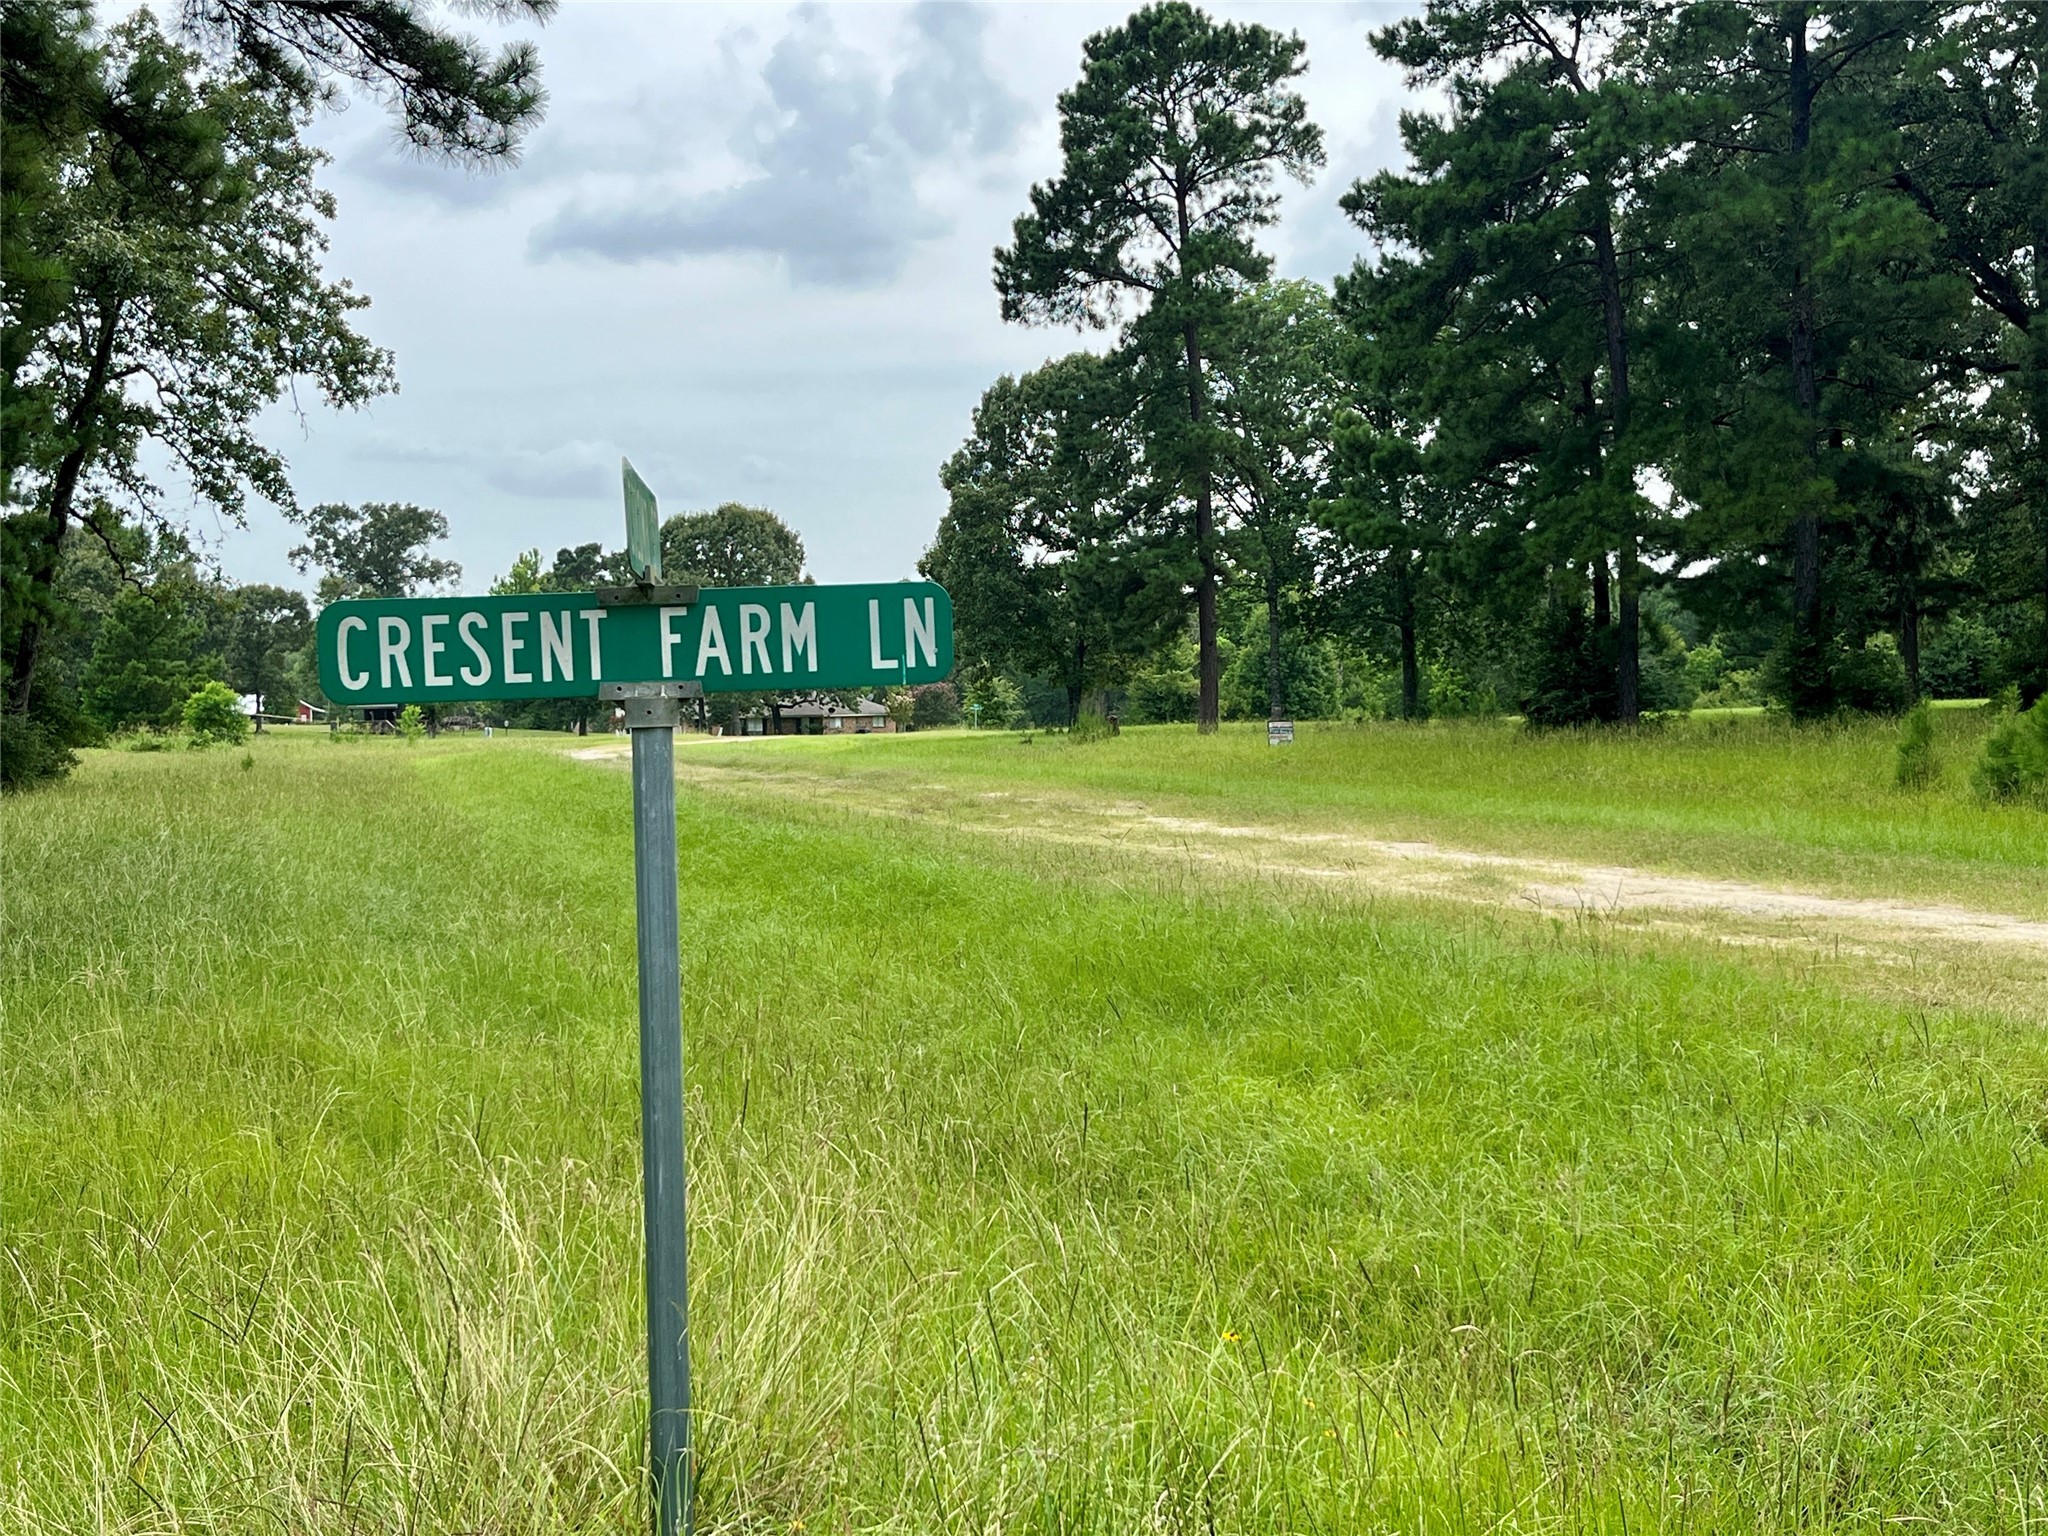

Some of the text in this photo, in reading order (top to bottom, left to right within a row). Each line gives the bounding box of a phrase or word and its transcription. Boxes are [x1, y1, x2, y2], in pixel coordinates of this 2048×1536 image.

[337, 597, 937, 690] CRESENT FARM LN
